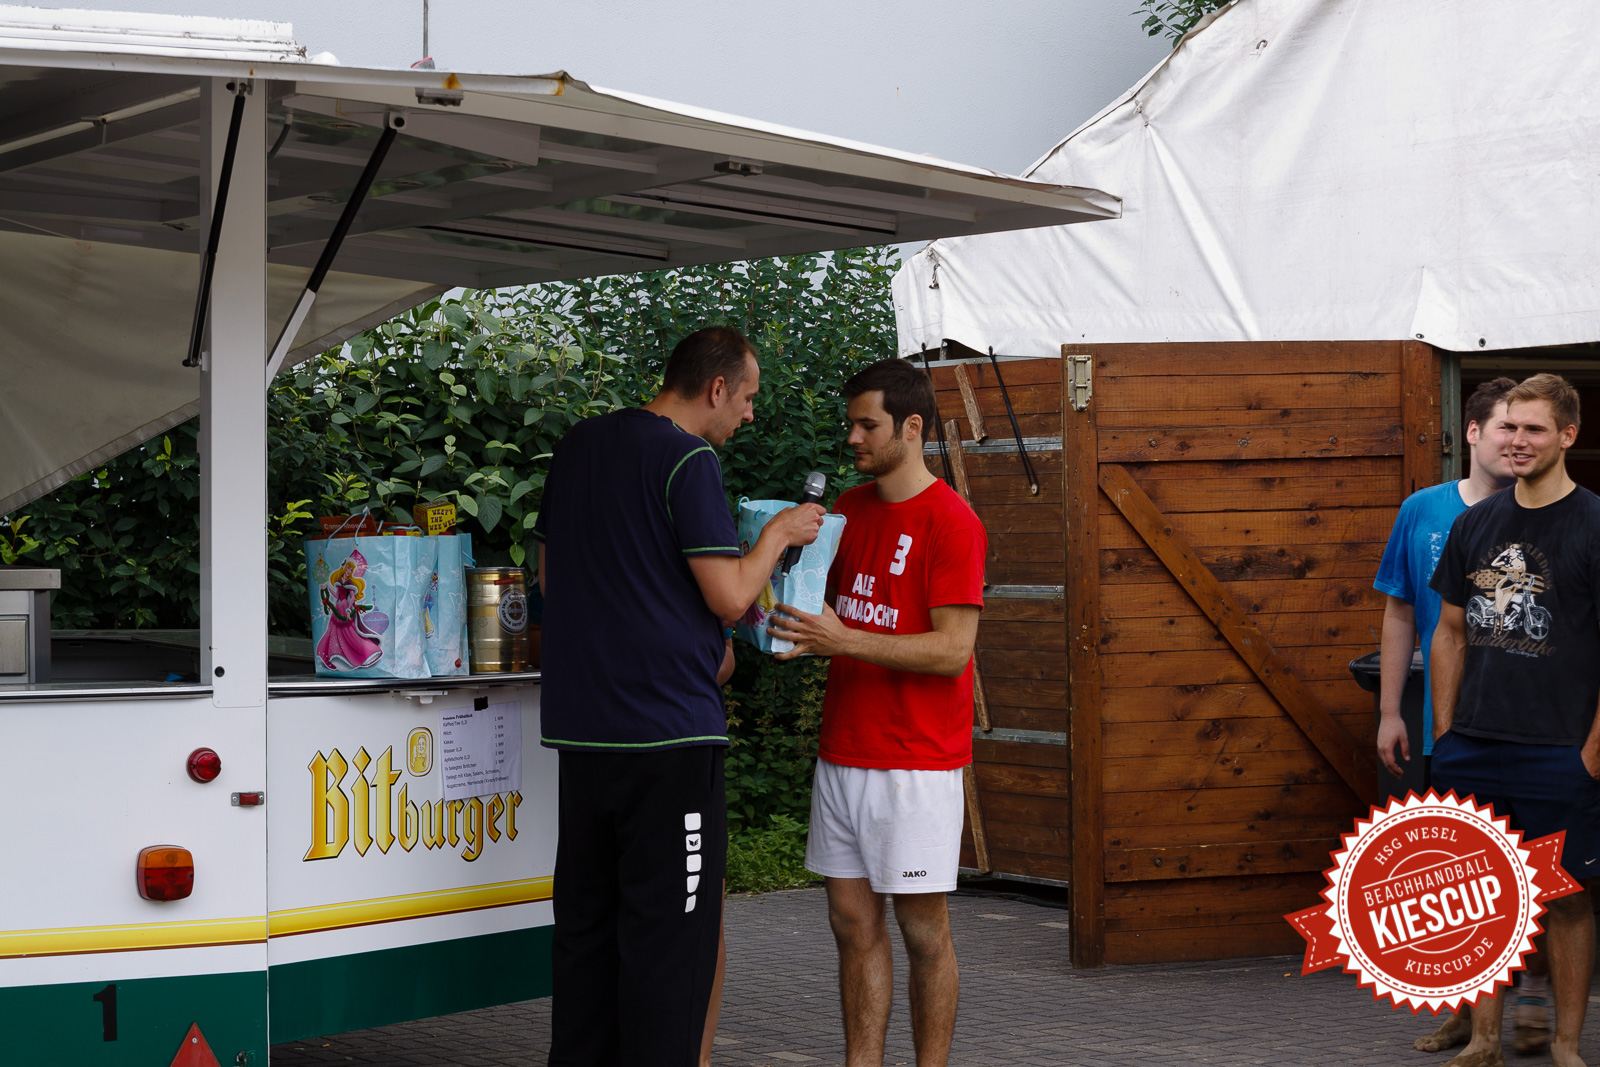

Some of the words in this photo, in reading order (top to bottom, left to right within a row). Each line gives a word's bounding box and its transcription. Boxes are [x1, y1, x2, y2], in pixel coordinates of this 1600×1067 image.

[889, 533, 913, 576] 3
[303, 745, 523, 862] Bitburger
[902, 870, 927, 878] JAKO
[93, 984, 118, 1042] 1
